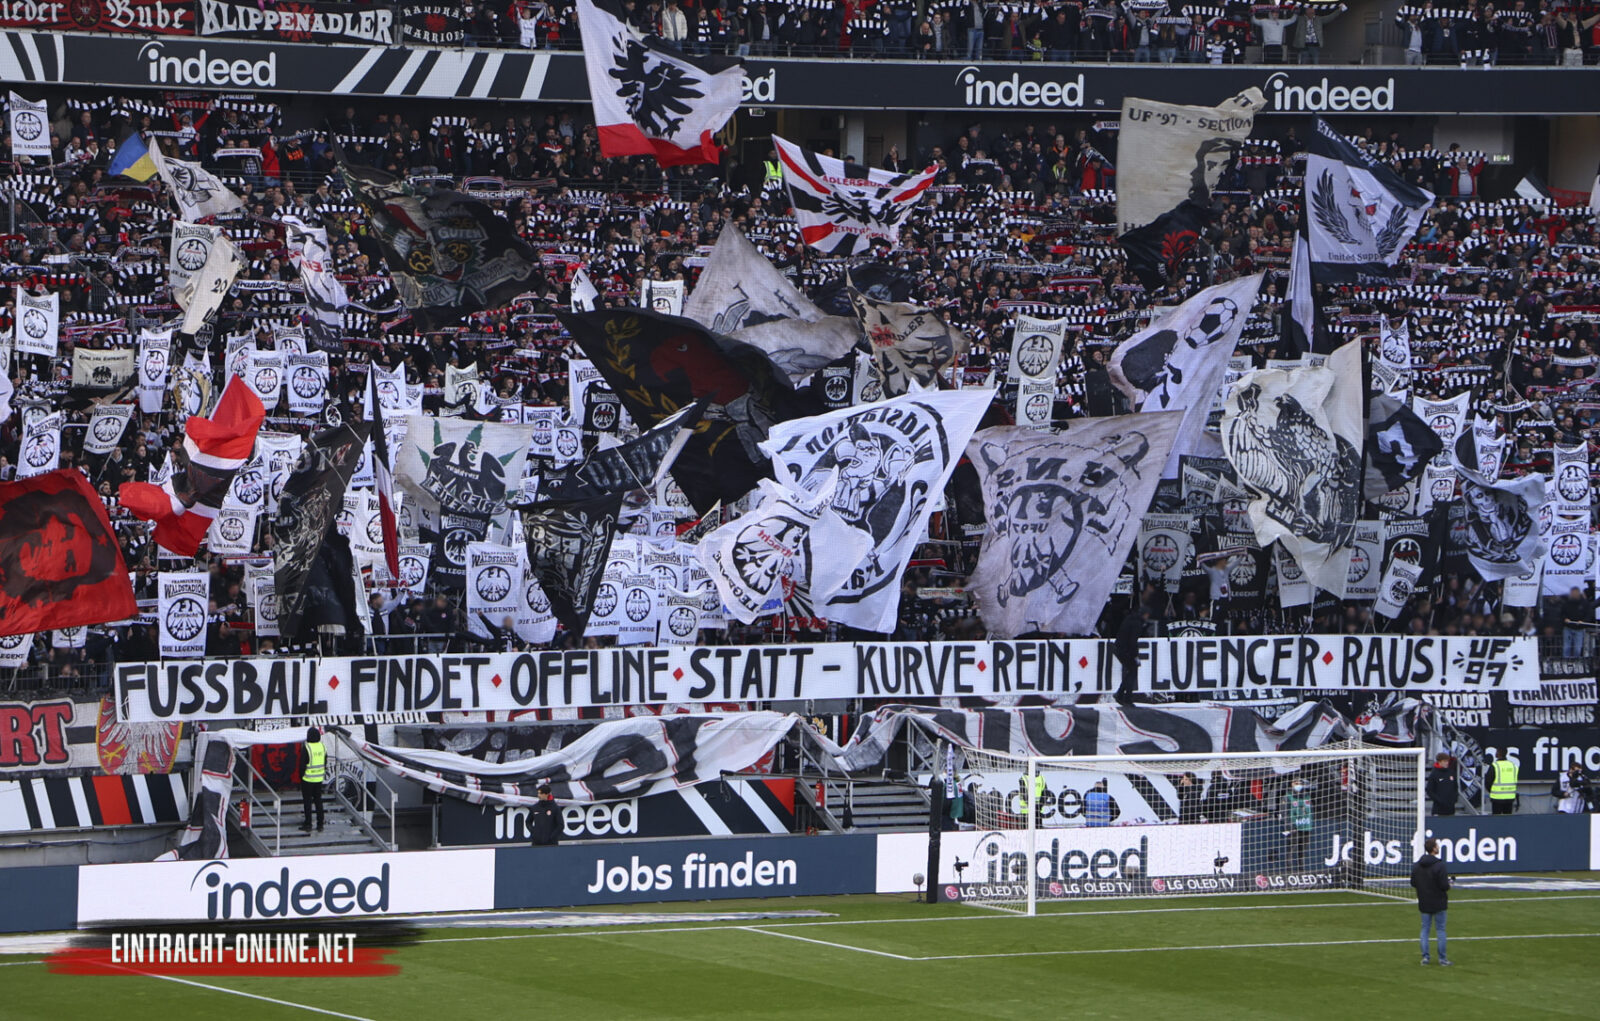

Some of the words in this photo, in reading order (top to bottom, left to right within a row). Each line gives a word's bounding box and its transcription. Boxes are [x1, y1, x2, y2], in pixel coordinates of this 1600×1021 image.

[0, 0, 64, 22] ieder
[105, 0, 187, 28] Bube
[200, 1, 393, 44] KLIPPENADLER
[146, 46, 277, 87] indeed
[963, 72, 1085, 108] indeed
[1272, 76, 1396, 112] indeed
[1128, 107, 1152, 122] UF
[164, 583, 207, 599] WALDSTADION
[1166, 620, 1217, 631] HIGH
[1468, 639, 1513, 659] UF
[119, 659, 329, 721] FUSSBALL
[351, 657, 491, 711] FINDET
[510, 650, 669, 706] OFFLINE
[689, 647, 814, 699] STATT
[856, 644, 976, 695] KURVE
[992, 641, 1083, 694] REIN,
[1096, 637, 1320, 693] INFLUENCER
[1342, 636, 1449, 687] RAUS!
[1463, 661, 1508, 687] 97
[1422, 693, 1492, 708] STADION
[1512, 682, 1597, 701] FRANKFURT
[1512, 705, 1596, 725] HOOLIGANS
[494, 799, 639, 839] ineed
[986, 833, 1148, 885] indeed
[588, 855, 673, 894] Jobs
[682, 850, 797, 889] finden
[1167, 879, 1182, 890] LG
[1187, 878, 1217, 889] OLED
[1218, 877, 1235, 888] TV
[1269, 876, 1284, 886] LG
[1288, 875, 1318, 886] OLED
[205, 861, 391, 920] indeed
[960, 886, 976, 898] LG
[980, 885, 1012, 897] OLED
[1064, 883, 1080, 894] LG
[1084, 882, 1115, 893] OLED
[1116, 881, 1132, 893] TV
